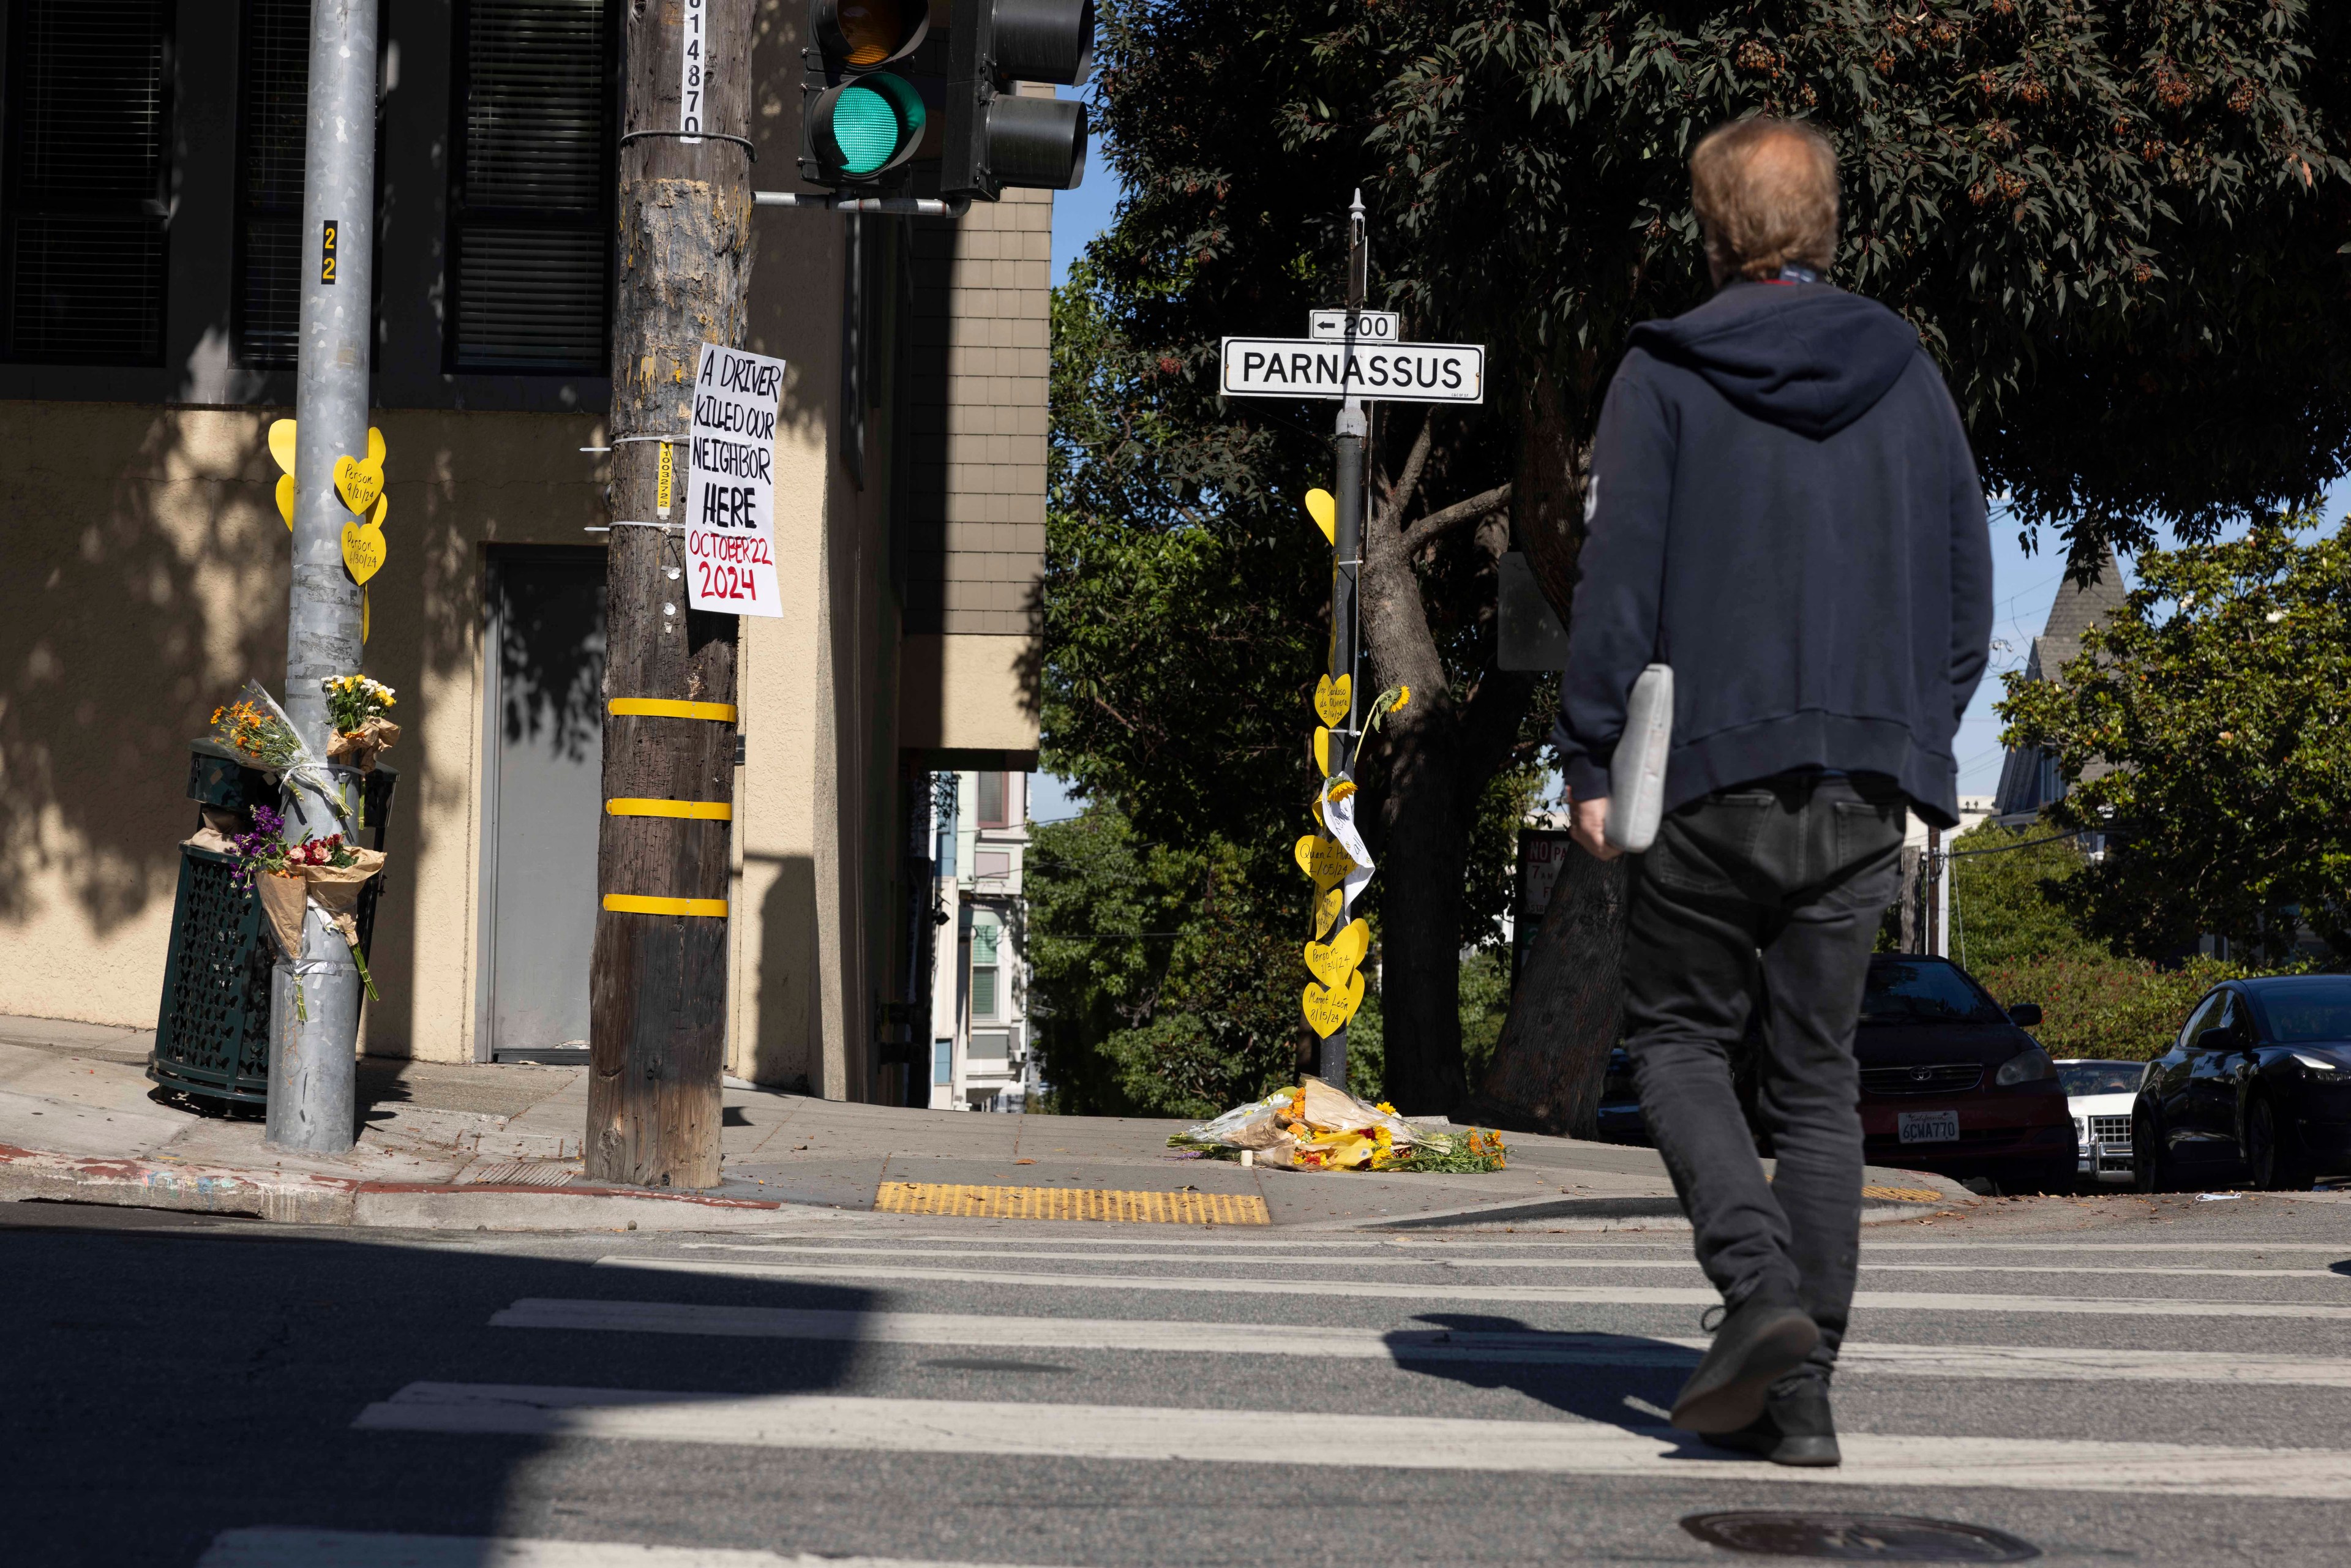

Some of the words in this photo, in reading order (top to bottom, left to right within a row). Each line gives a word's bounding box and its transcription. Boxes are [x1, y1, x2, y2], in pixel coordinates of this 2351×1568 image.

[1344, 317, 1388, 337] 200
[701, 350, 714, 386] A
[721, 354, 781, 403] DRIVER
[1243, 352, 1461, 389] PARNASSUS
[694, 394, 744, 433] KILLED
[747, 407, 774, 440] OUR
[693, 436, 771, 485] NEIGHBOR
[345, 463, 373, 484] Person
[659, 451, 670, 507] 10032722
[347, 482, 373, 504] 9/21/24
[703, 482, 757, 528] HERE
[347, 531, 374, 552] Person
[690, 530, 749, 564] OCTOBER
[749, 538, 773, 566] 22
[350, 552, 377, 568] 6/30/24
[699, 561, 756, 601] 2024
[1300, 844, 1325, 859] Quan
[1531, 841, 1548, 860] NO
[1308, 861, 1348, 879] 2/05/24
[1532, 866, 1540, 879] 7
[1313, 948, 1338, 962] Person
[1321, 955, 1350, 976] 1/31/24
[1309, 990, 1329, 1010] Margot
[1311, 1008, 1339, 1024] 8/15/24
[1903, 1122, 1955, 1139] 6CWA770
